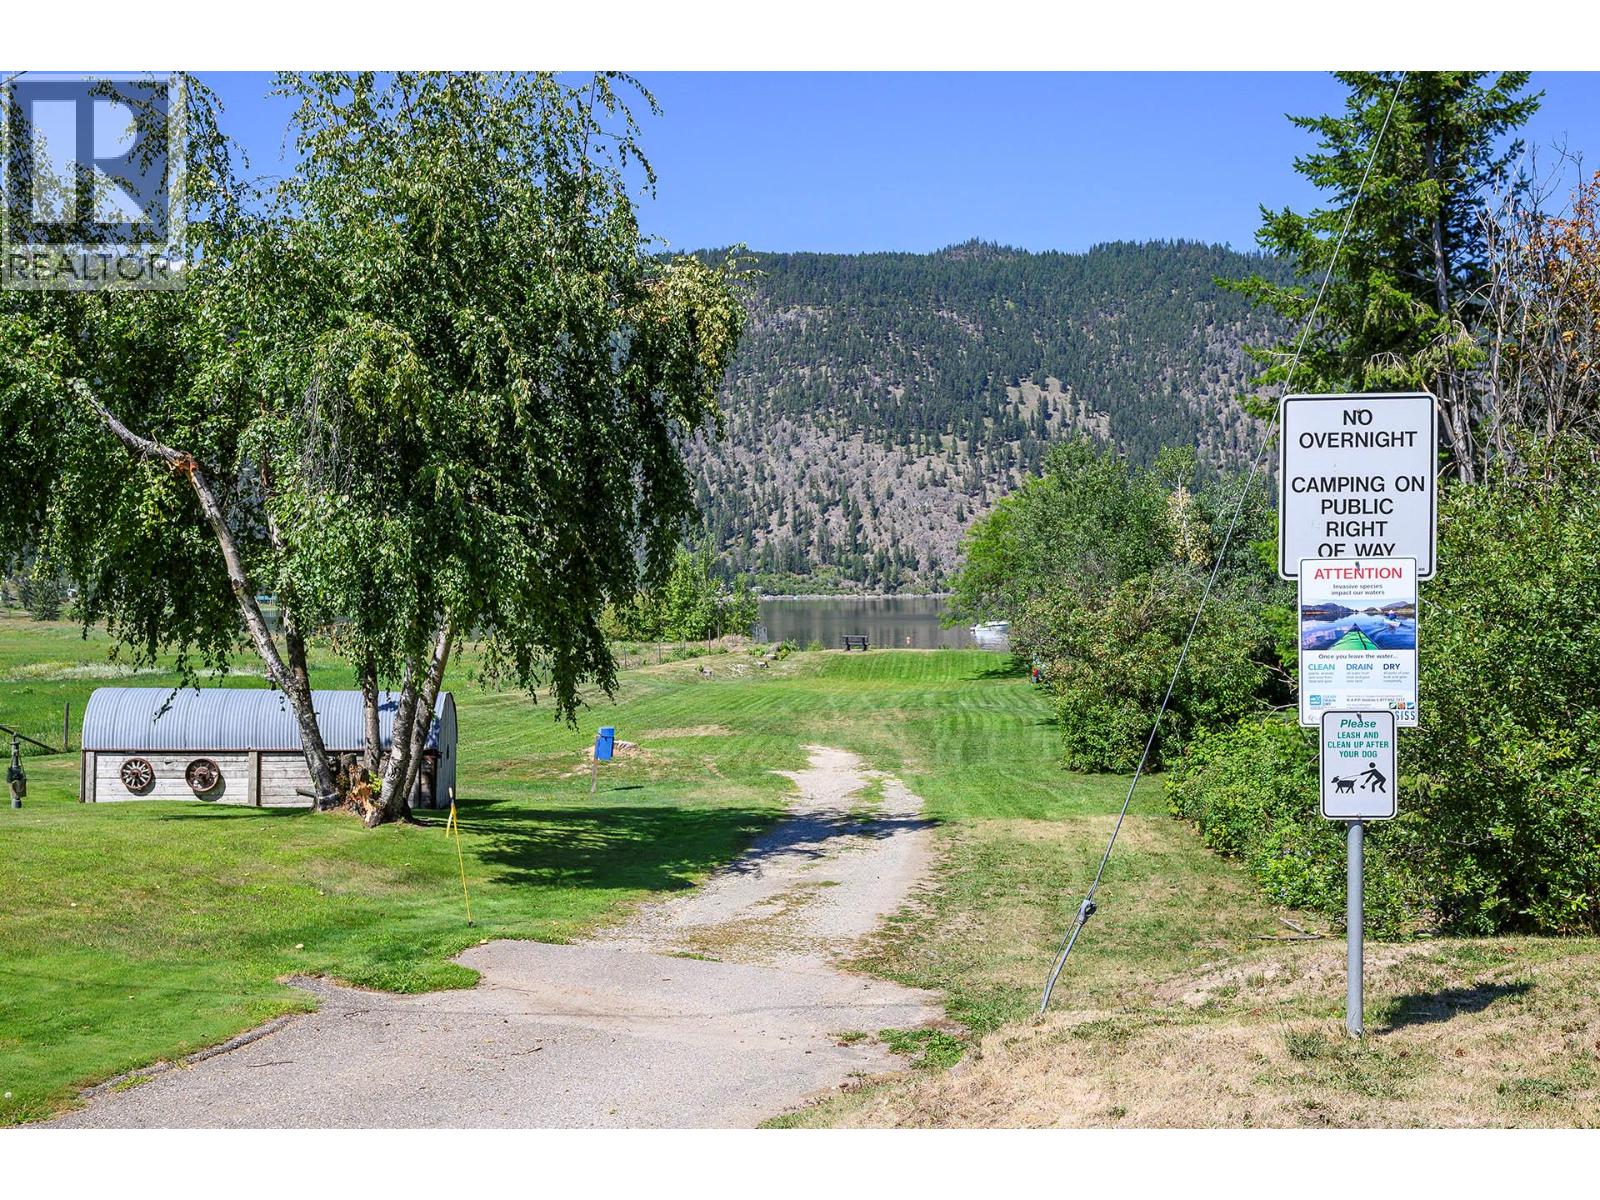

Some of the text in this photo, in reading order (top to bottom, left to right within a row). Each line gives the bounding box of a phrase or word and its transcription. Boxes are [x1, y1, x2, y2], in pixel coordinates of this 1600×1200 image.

[1343, 409, 1373, 426] NO
[1299, 431, 1418, 448] OVERNIGHT
[1291, 476, 1425, 493] CAMPING ON
[1321, 498, 1394, 515] PUBLIC
[1326, 521, 1388, 537] RIGHT
[1318, 543, 1396, 557] OF WAY
[1314, 567, 1402, 580] ATTENTION
[1307, 663, 1401, 671] CLEAN DRAIN DRY
[1340, 719, 1377, 728] Please
[1337, 731, 1379, 739] LEASH AND
[1327, 741, 1389, 749] CLEAN UP AFTER
[1339, 750, 1378, 758] YOUR DOG
